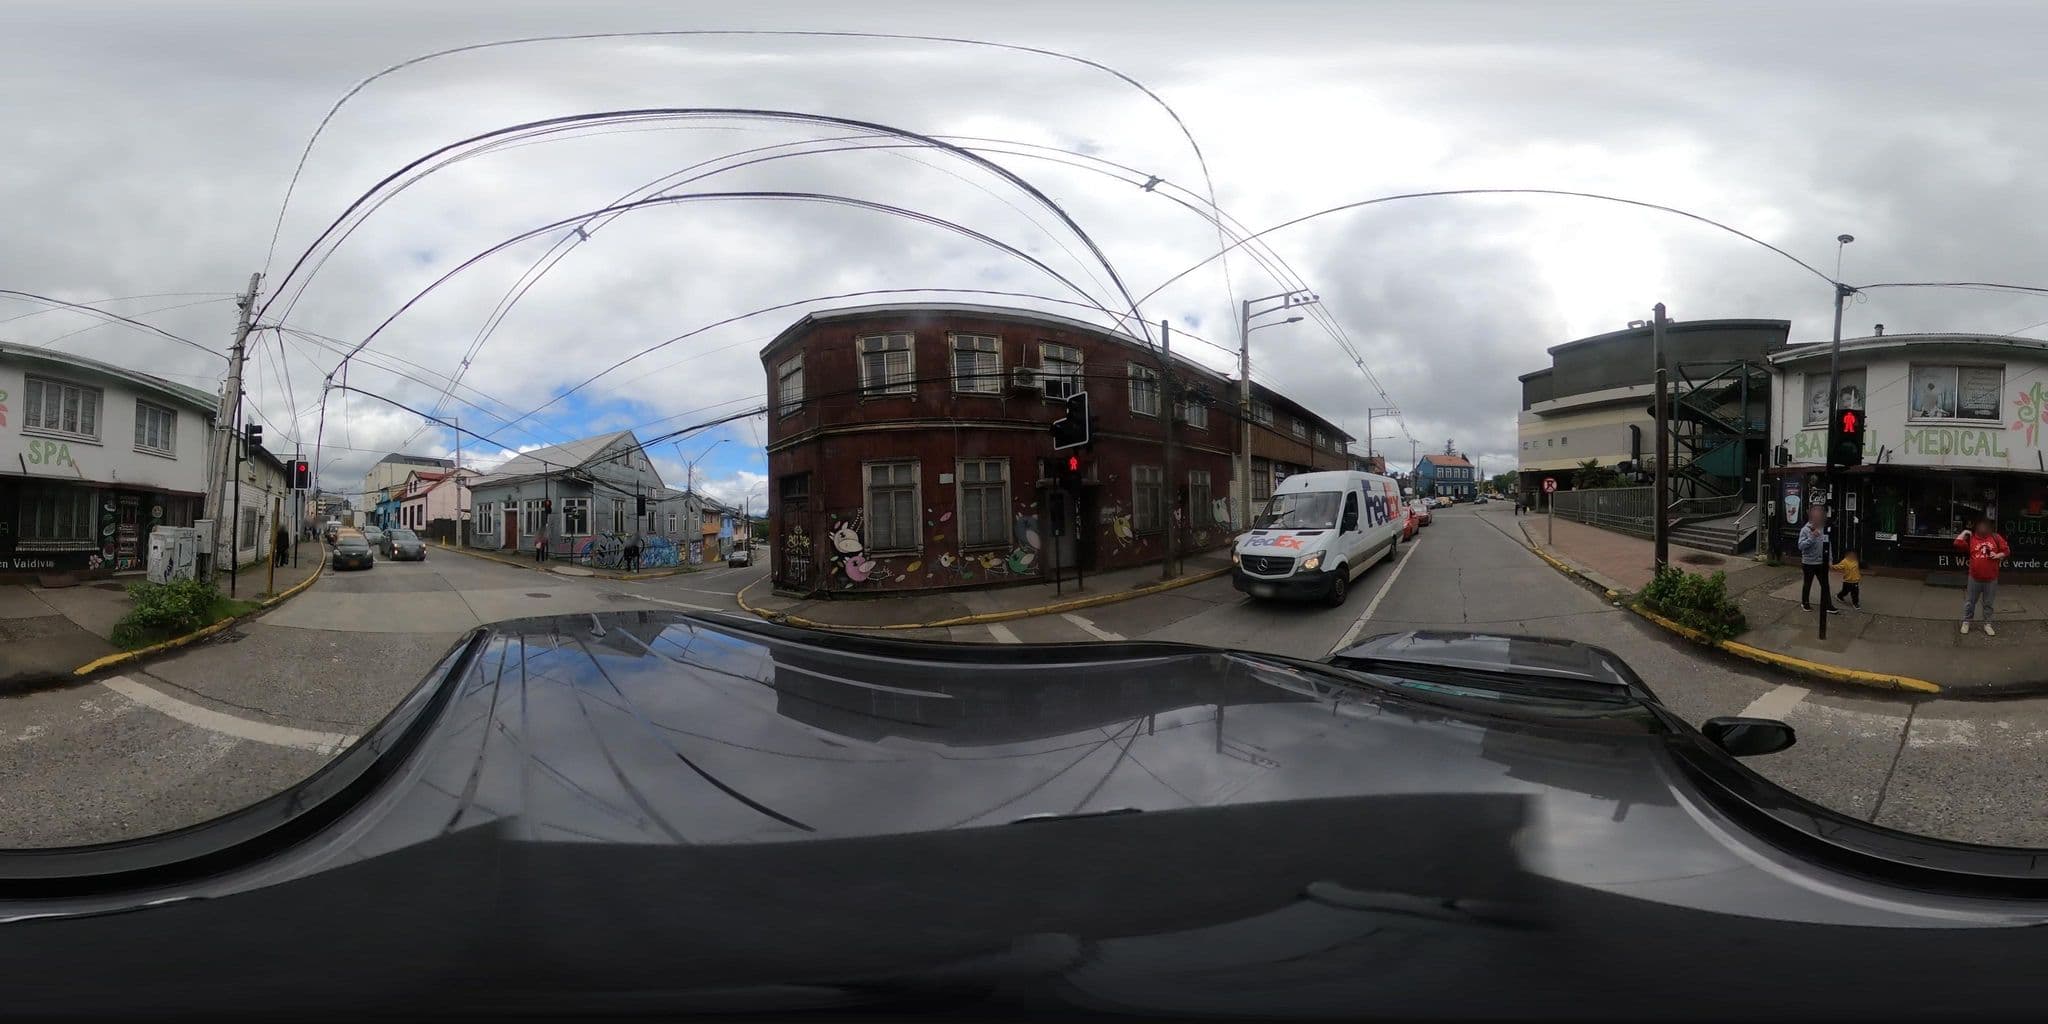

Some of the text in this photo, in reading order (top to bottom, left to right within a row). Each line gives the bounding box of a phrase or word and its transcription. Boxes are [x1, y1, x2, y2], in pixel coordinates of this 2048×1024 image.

[28, 440, 73, 467] SPA
[1904, 429, 2009, 458] MEDICAL
[1361, 479, 1398, 528] FedEx
[1244, 534, 1305, 550] FedEx
[1938, 555, 1949, 567] El
[2012, 558, 2041, 568] verde
